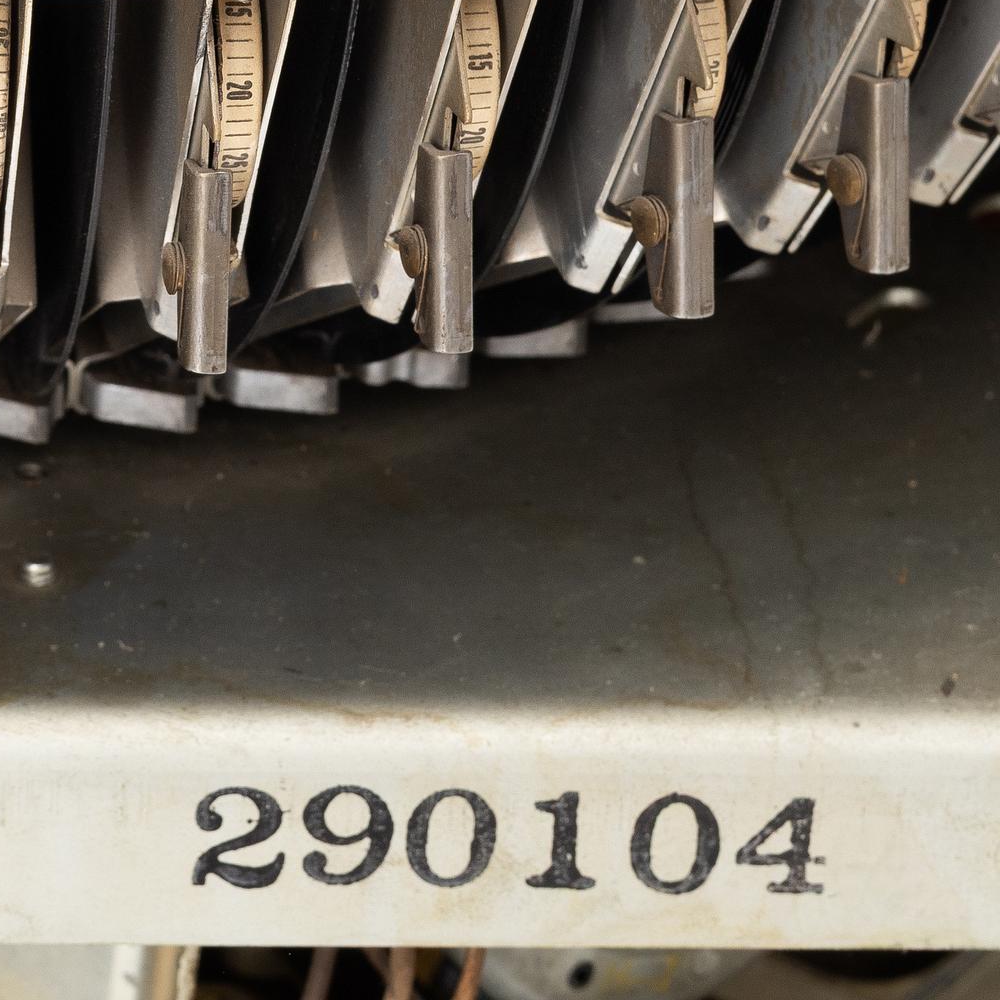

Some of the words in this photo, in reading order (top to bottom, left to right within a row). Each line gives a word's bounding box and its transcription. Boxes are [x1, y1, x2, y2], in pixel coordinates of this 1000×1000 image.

[468, 52, 493, 71] 15
[226, 80, 253, 101] 20
[460, 127, 487, 145] 20
[221, 152, 249, 169] 25
[192, 784, 826, 894] 290104
